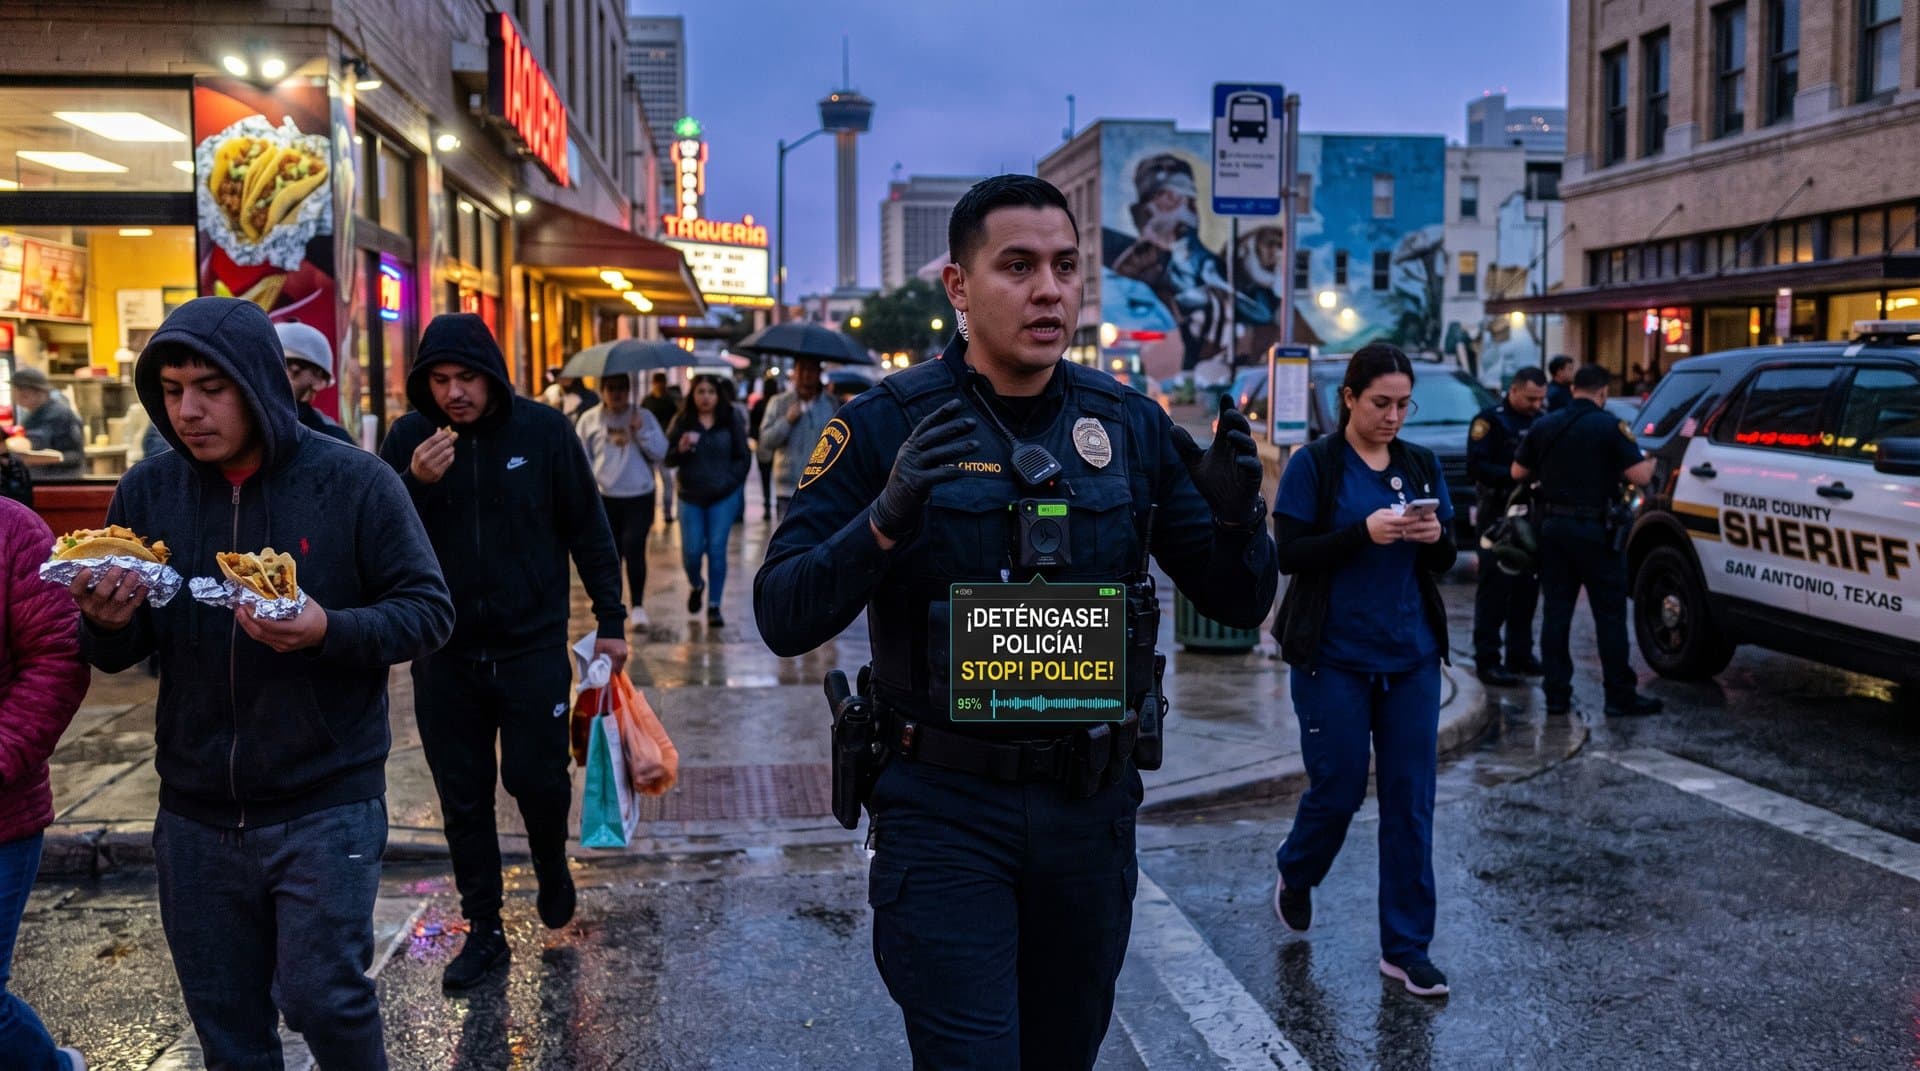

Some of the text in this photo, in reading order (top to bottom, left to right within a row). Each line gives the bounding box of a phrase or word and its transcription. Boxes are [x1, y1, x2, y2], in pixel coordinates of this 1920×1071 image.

[1723, 492, 1831, 522] BEXAR COUNTY
[1723, 509, 1911, 580] SHERIFF
[1725, 559, 1903, 612] SAN ANTONIO, TEXAS
